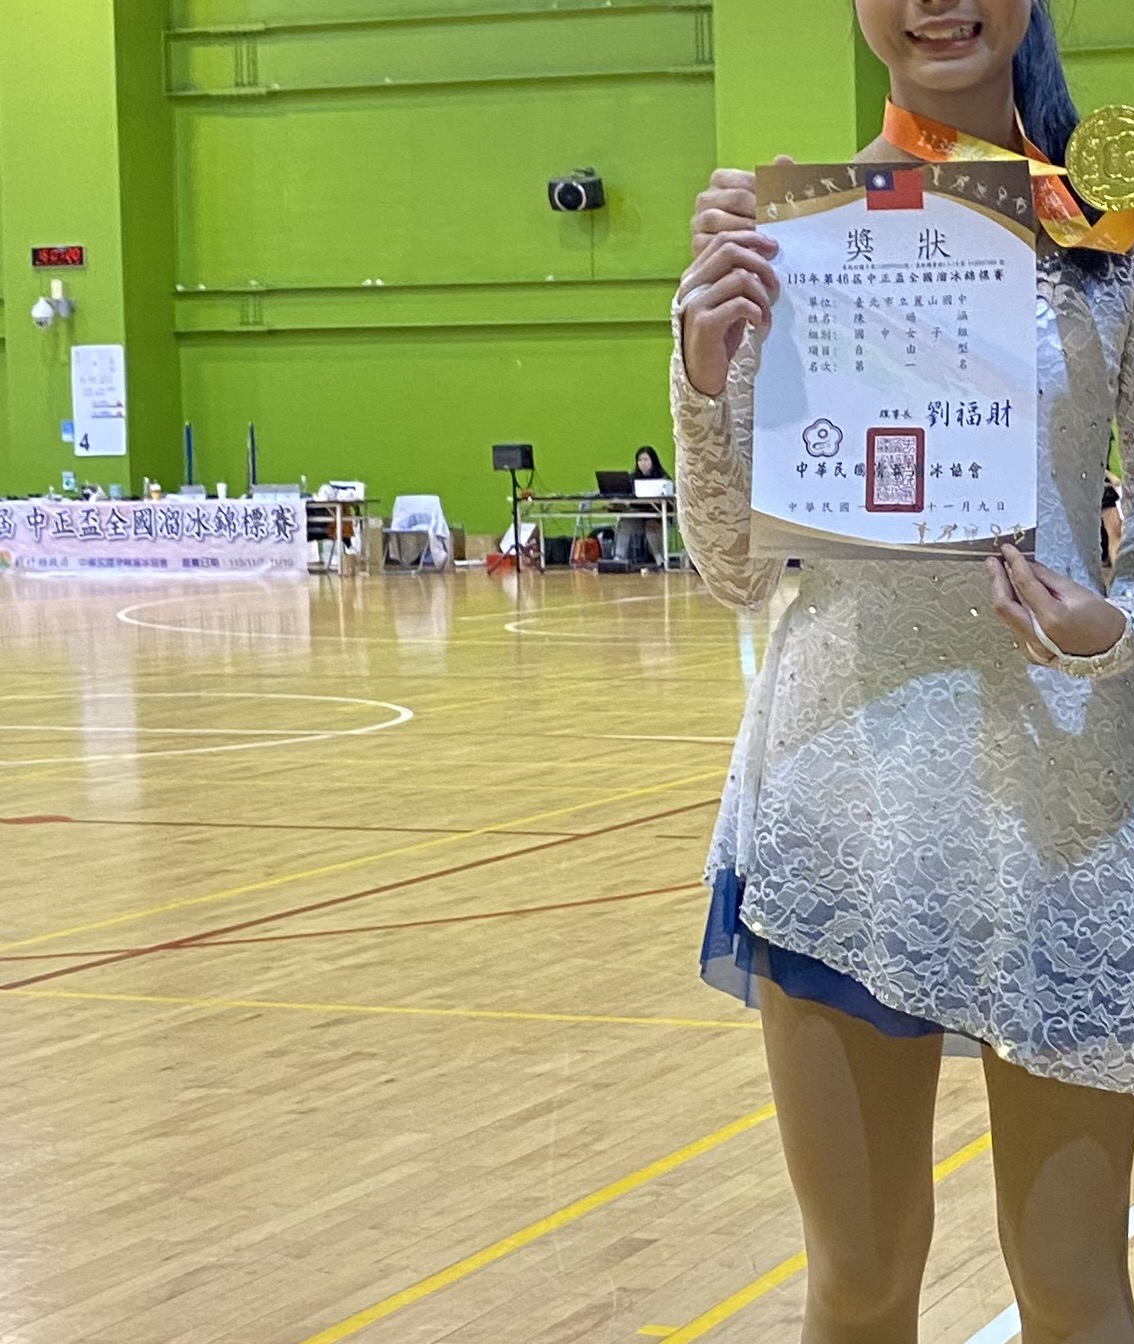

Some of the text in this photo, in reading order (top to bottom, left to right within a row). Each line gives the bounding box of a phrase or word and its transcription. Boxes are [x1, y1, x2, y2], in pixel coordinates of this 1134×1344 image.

[846, 228, 951, 260] 獎狀
[927, 399, 1012, 428] 劉福財
[796, 461, 982, 478] 中華民國冰協會
